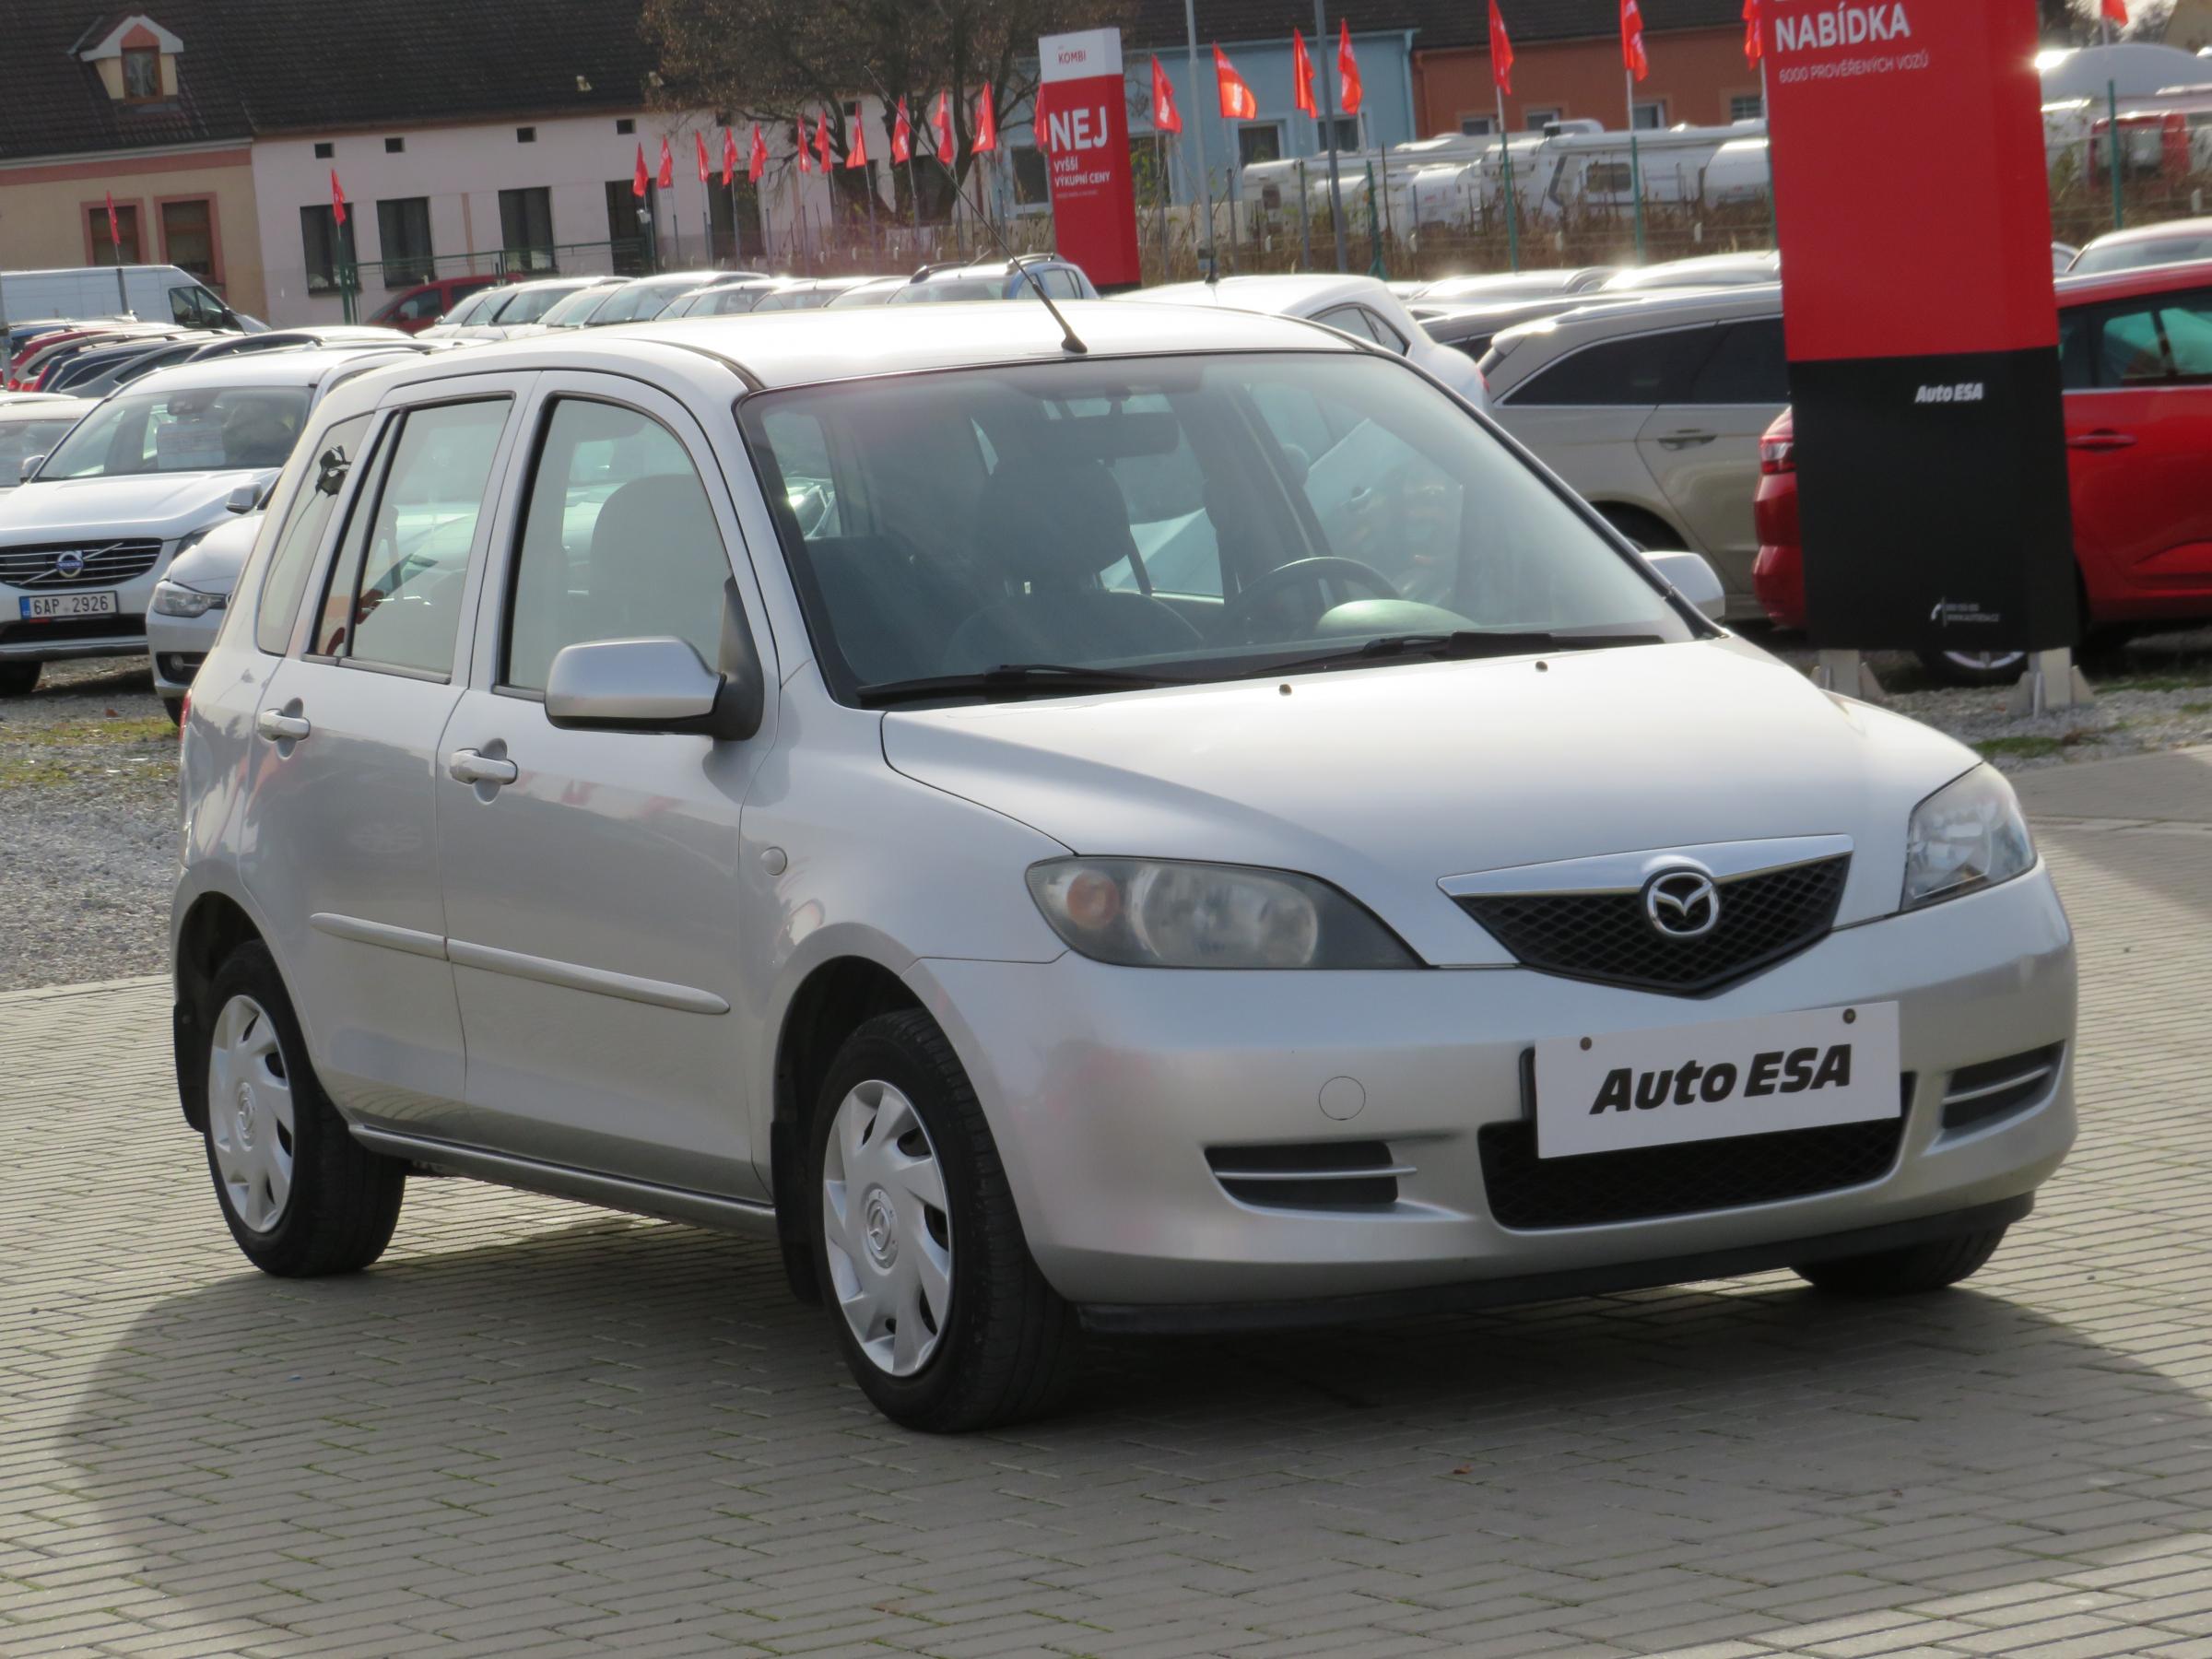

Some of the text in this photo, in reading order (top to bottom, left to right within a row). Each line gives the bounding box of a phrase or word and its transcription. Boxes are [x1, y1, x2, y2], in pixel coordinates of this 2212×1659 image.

[1775, 2, 1911, 53] NABÍDKA
[1058, 50, 1087, 65] KOMBI
[1049, 105, 1108, 153] NEJ
[1089, 171, 1111, 184] CENY
[1914, 382, 1983, 403] Auto ESA
[33, 599, 60, 616] 6AP
[72, 595, 109, 613] 2926
[1589, 1043, 1852, 1115] Auto ESA
